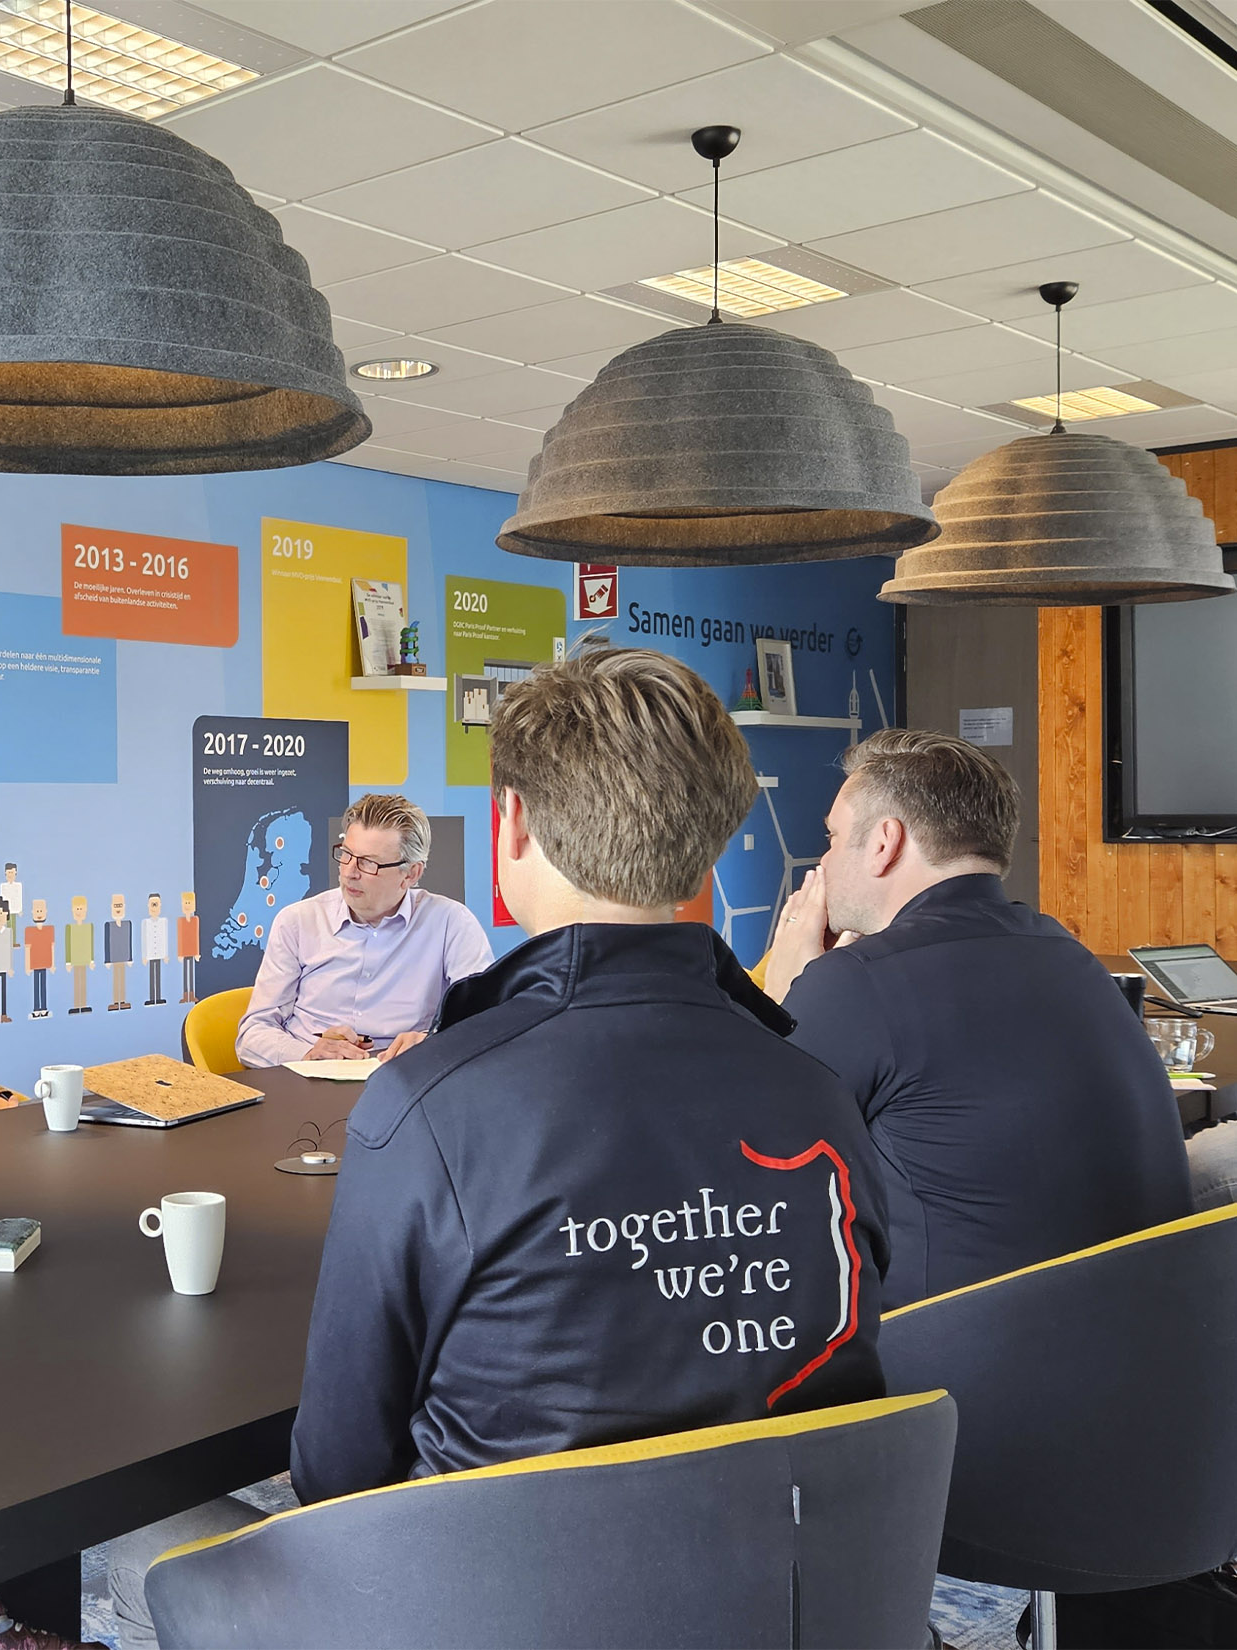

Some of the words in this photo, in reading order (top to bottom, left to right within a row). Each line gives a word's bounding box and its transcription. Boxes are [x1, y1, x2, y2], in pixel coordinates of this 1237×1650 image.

[272, 535, 313, 560] 2019
[74, 543, 124, 572] 2013
[142, 552, 189, 580] 2016
[453, 590, 488, 613] 2020
[628, 602, 695, 639] Samen
[700, 617, 745, 647] gaan
[750, 623, 775, 645] we
[780, 622, 834, 653] verder
[20, 652, 34, 660] naar
[48, 654, 102, 664] multidimensionale
[20, 662, 44, 672] heldere
[61, 664, 100, 675] transparantie
[203, 732, 248, 756] 2017
[263, 734, 305, 757] 2020
[203, 767, 211, 775] De
[559, 1187, 787, 1270] together
[654, 1254, 791, 1300] we're
[702, 1316, 796, 1354] one
